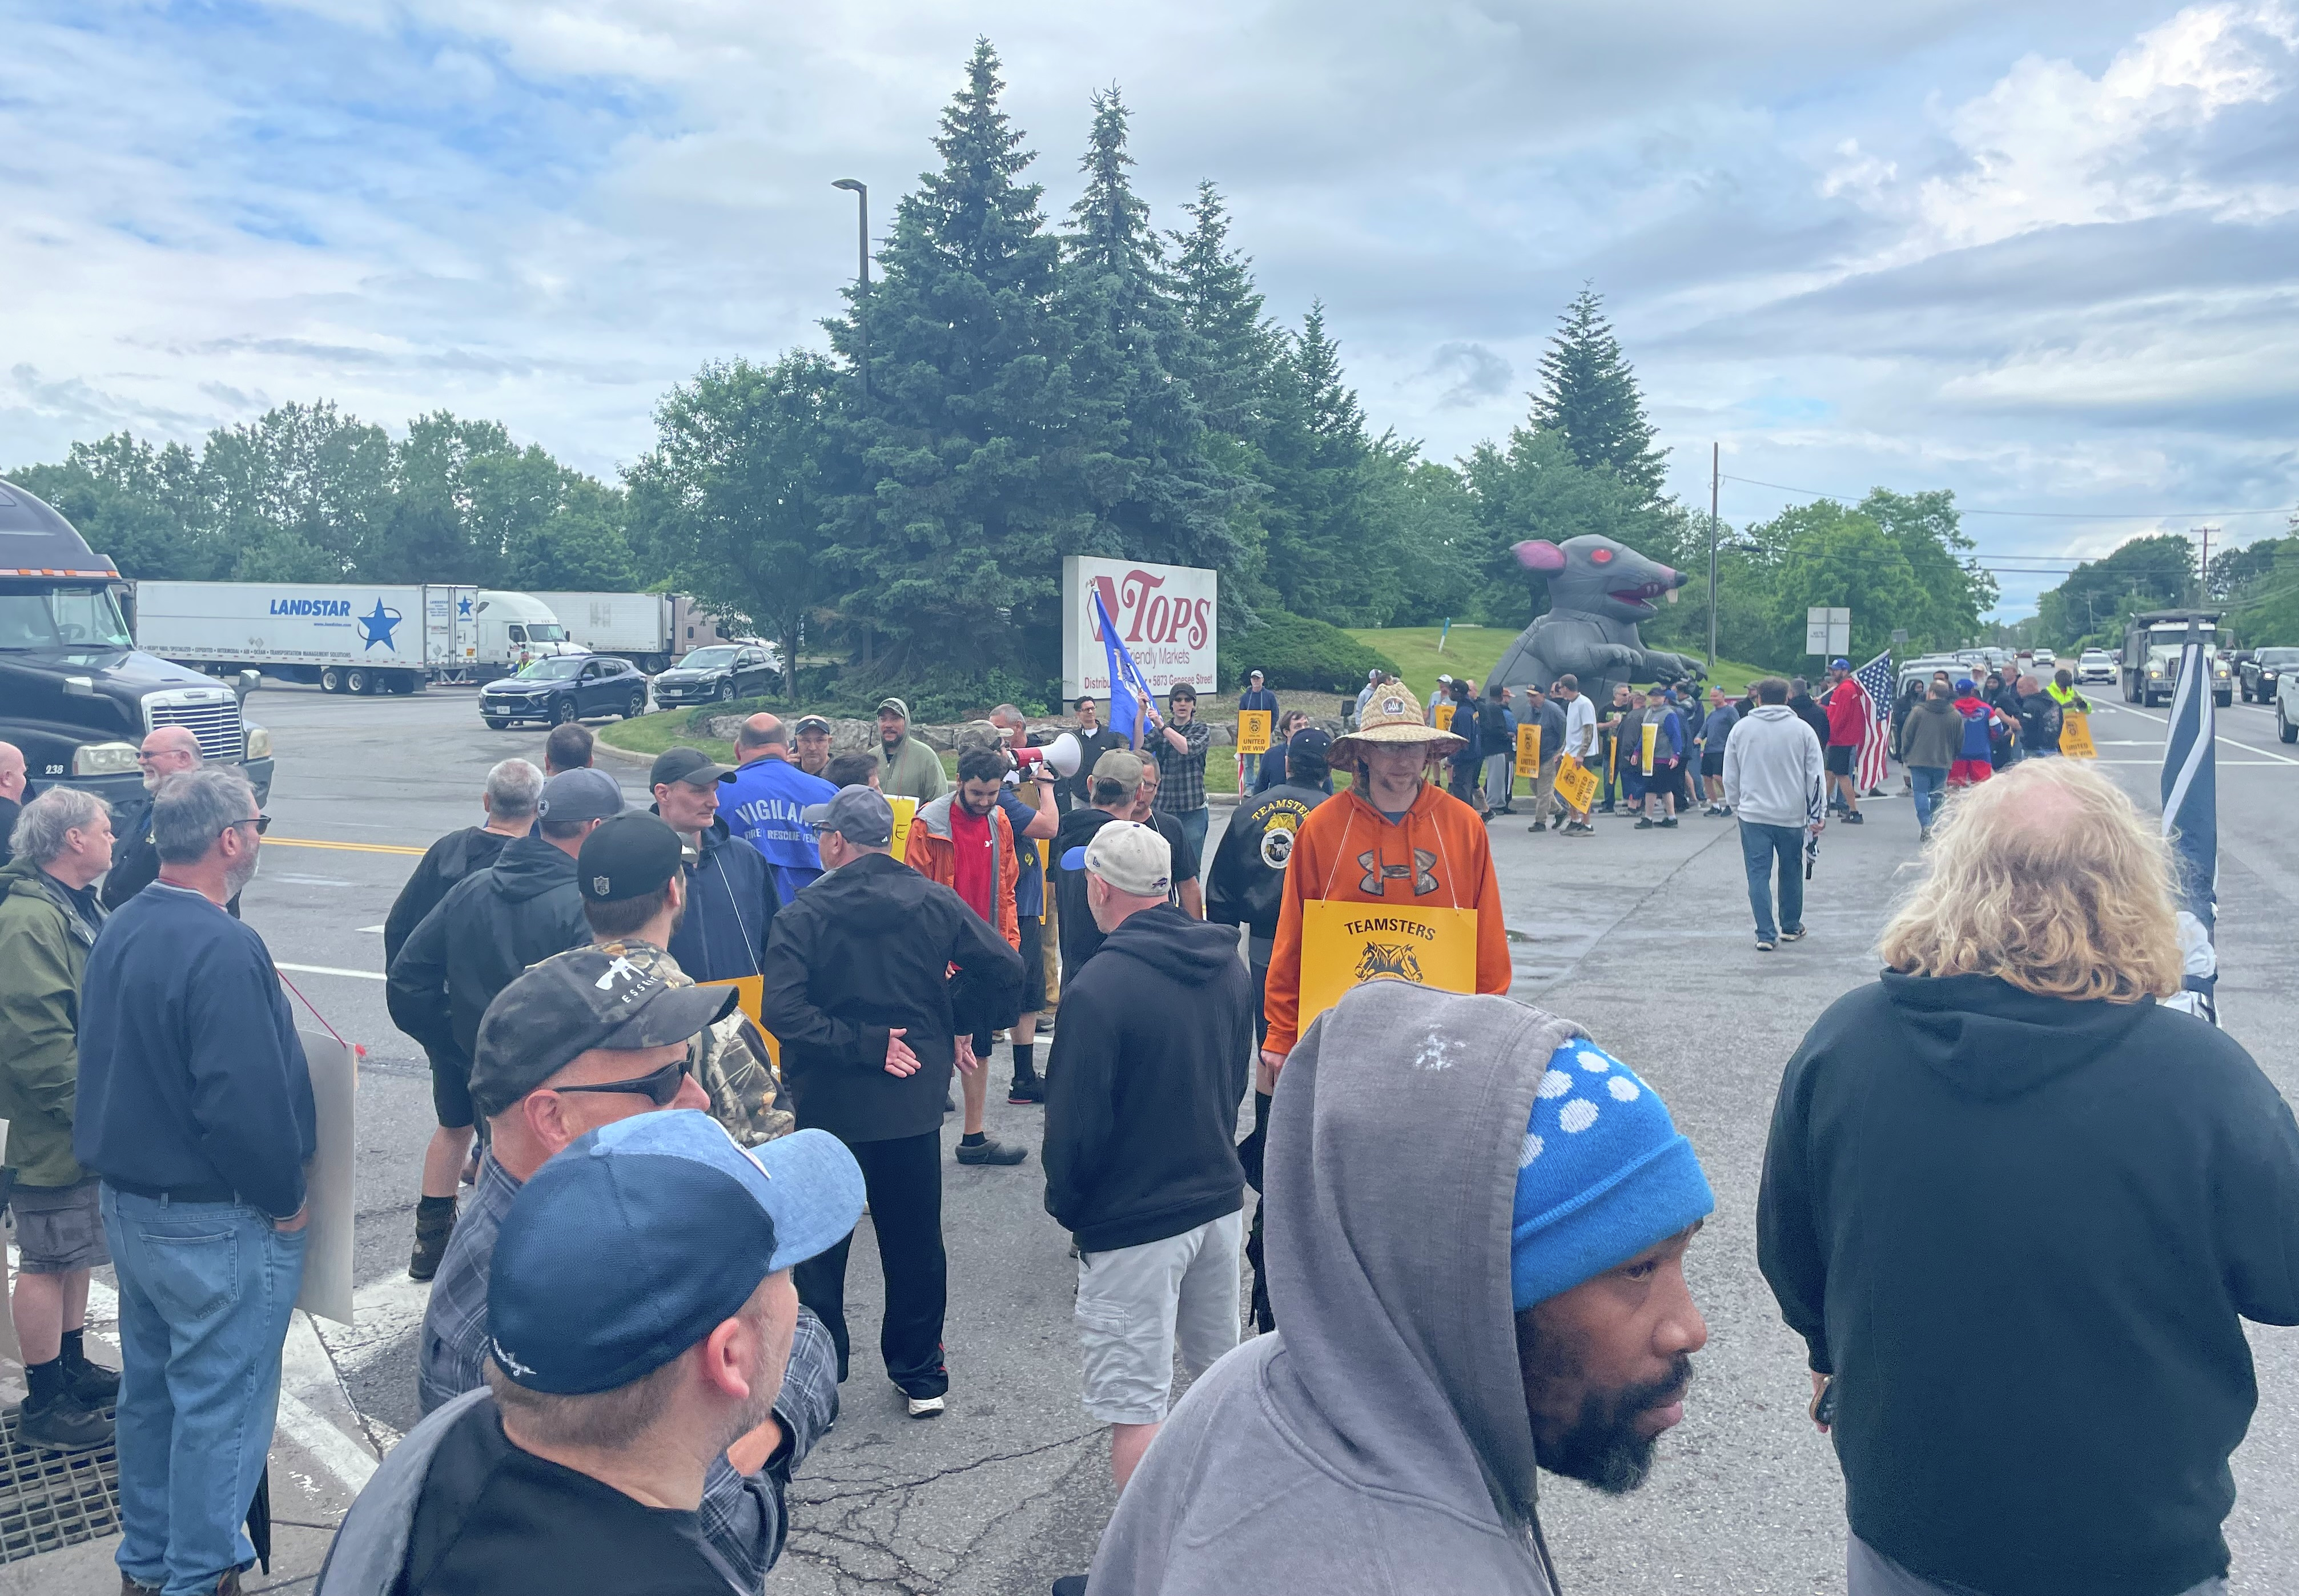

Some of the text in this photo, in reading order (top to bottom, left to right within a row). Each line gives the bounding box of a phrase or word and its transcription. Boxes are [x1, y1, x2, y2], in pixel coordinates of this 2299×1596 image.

[270, 599, 351, 616] LANDSTAR
[1125, 647, 1189, 669] riendly Markets
[1153, 675, 1168, 686] 5873
[1169, 674, 1195, 686] Genesee
[1196, 673, 1213, 685] Street
[45, 764, 64, 774] 238
[1575, 777, 1588, 802] UNITED
[1581, 779, 1595, 807] WE WIN
[744, 828, 762, 841] FIRE
[767, 830, 801, 842] RESCUE
[1344, 918, 1436, 941] TEAMSTERS
